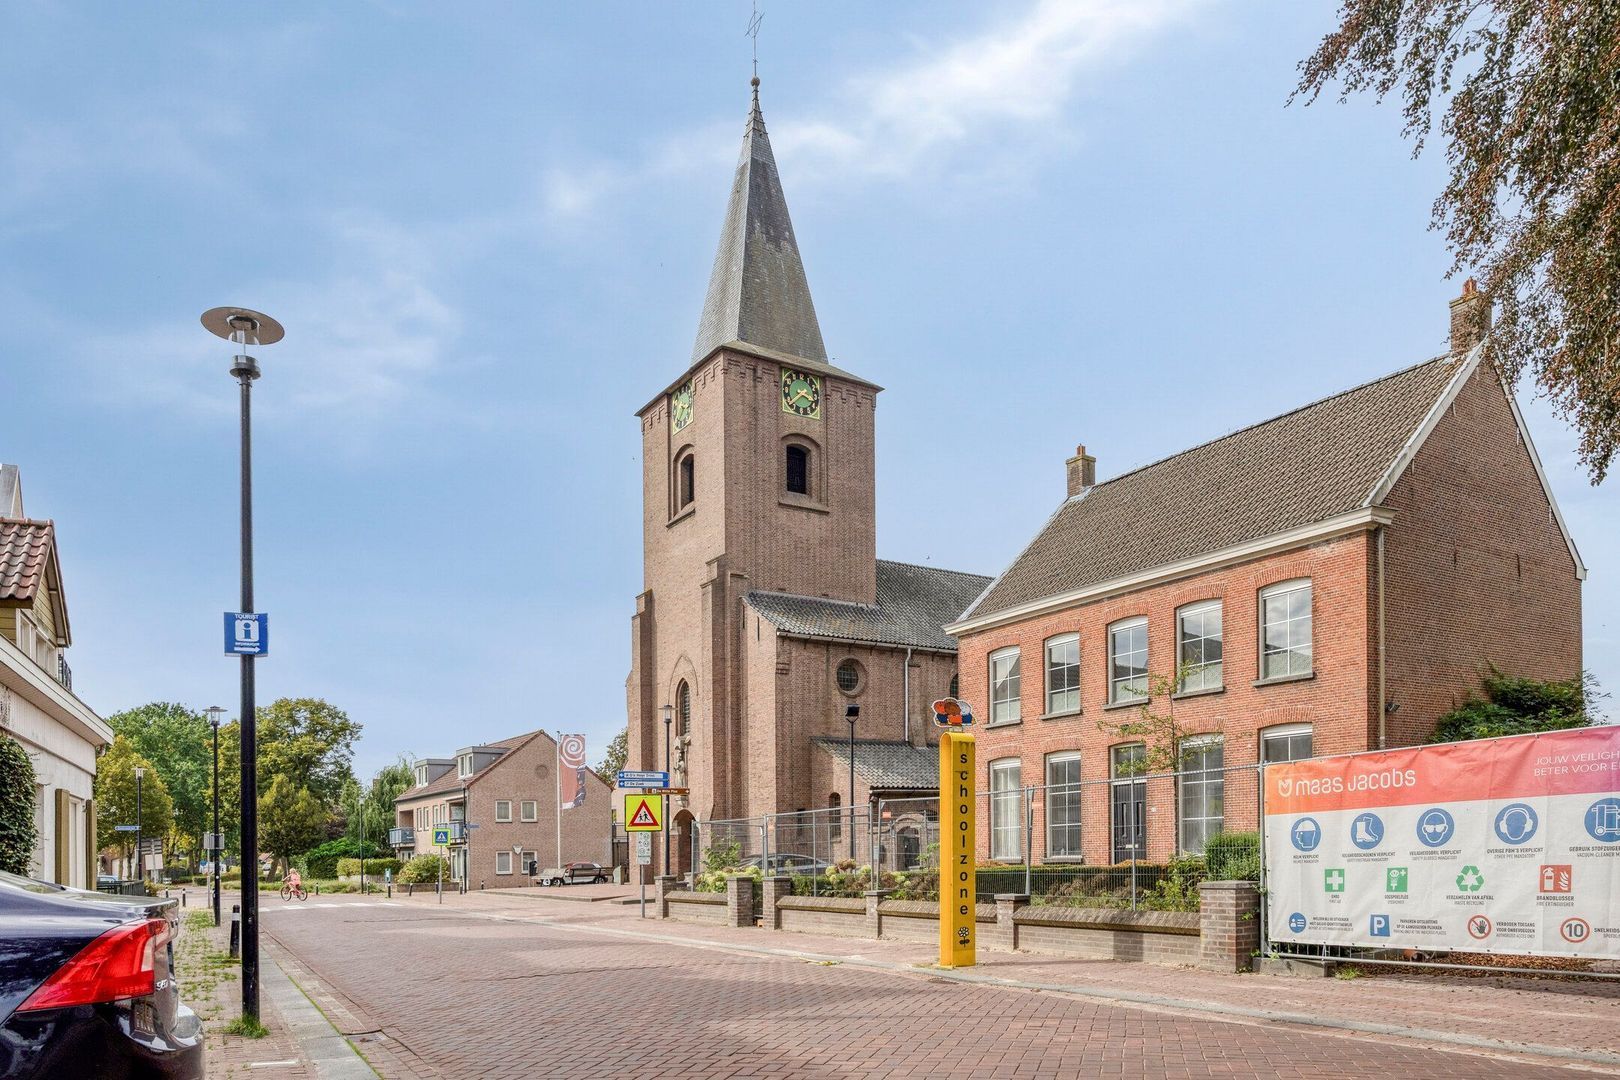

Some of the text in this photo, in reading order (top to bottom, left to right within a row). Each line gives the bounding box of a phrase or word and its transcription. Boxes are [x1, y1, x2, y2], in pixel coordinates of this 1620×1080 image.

[1535, 755, 1569, 766] JOUW
[1534, 765, 1569, 777] BETER
[1571, 762, 1608, 773] VOOR
[959, 753, 968, 915] schoolzone
[1374, 917, 1385, 934] P
[1566, 923, 1583, 938] 10
